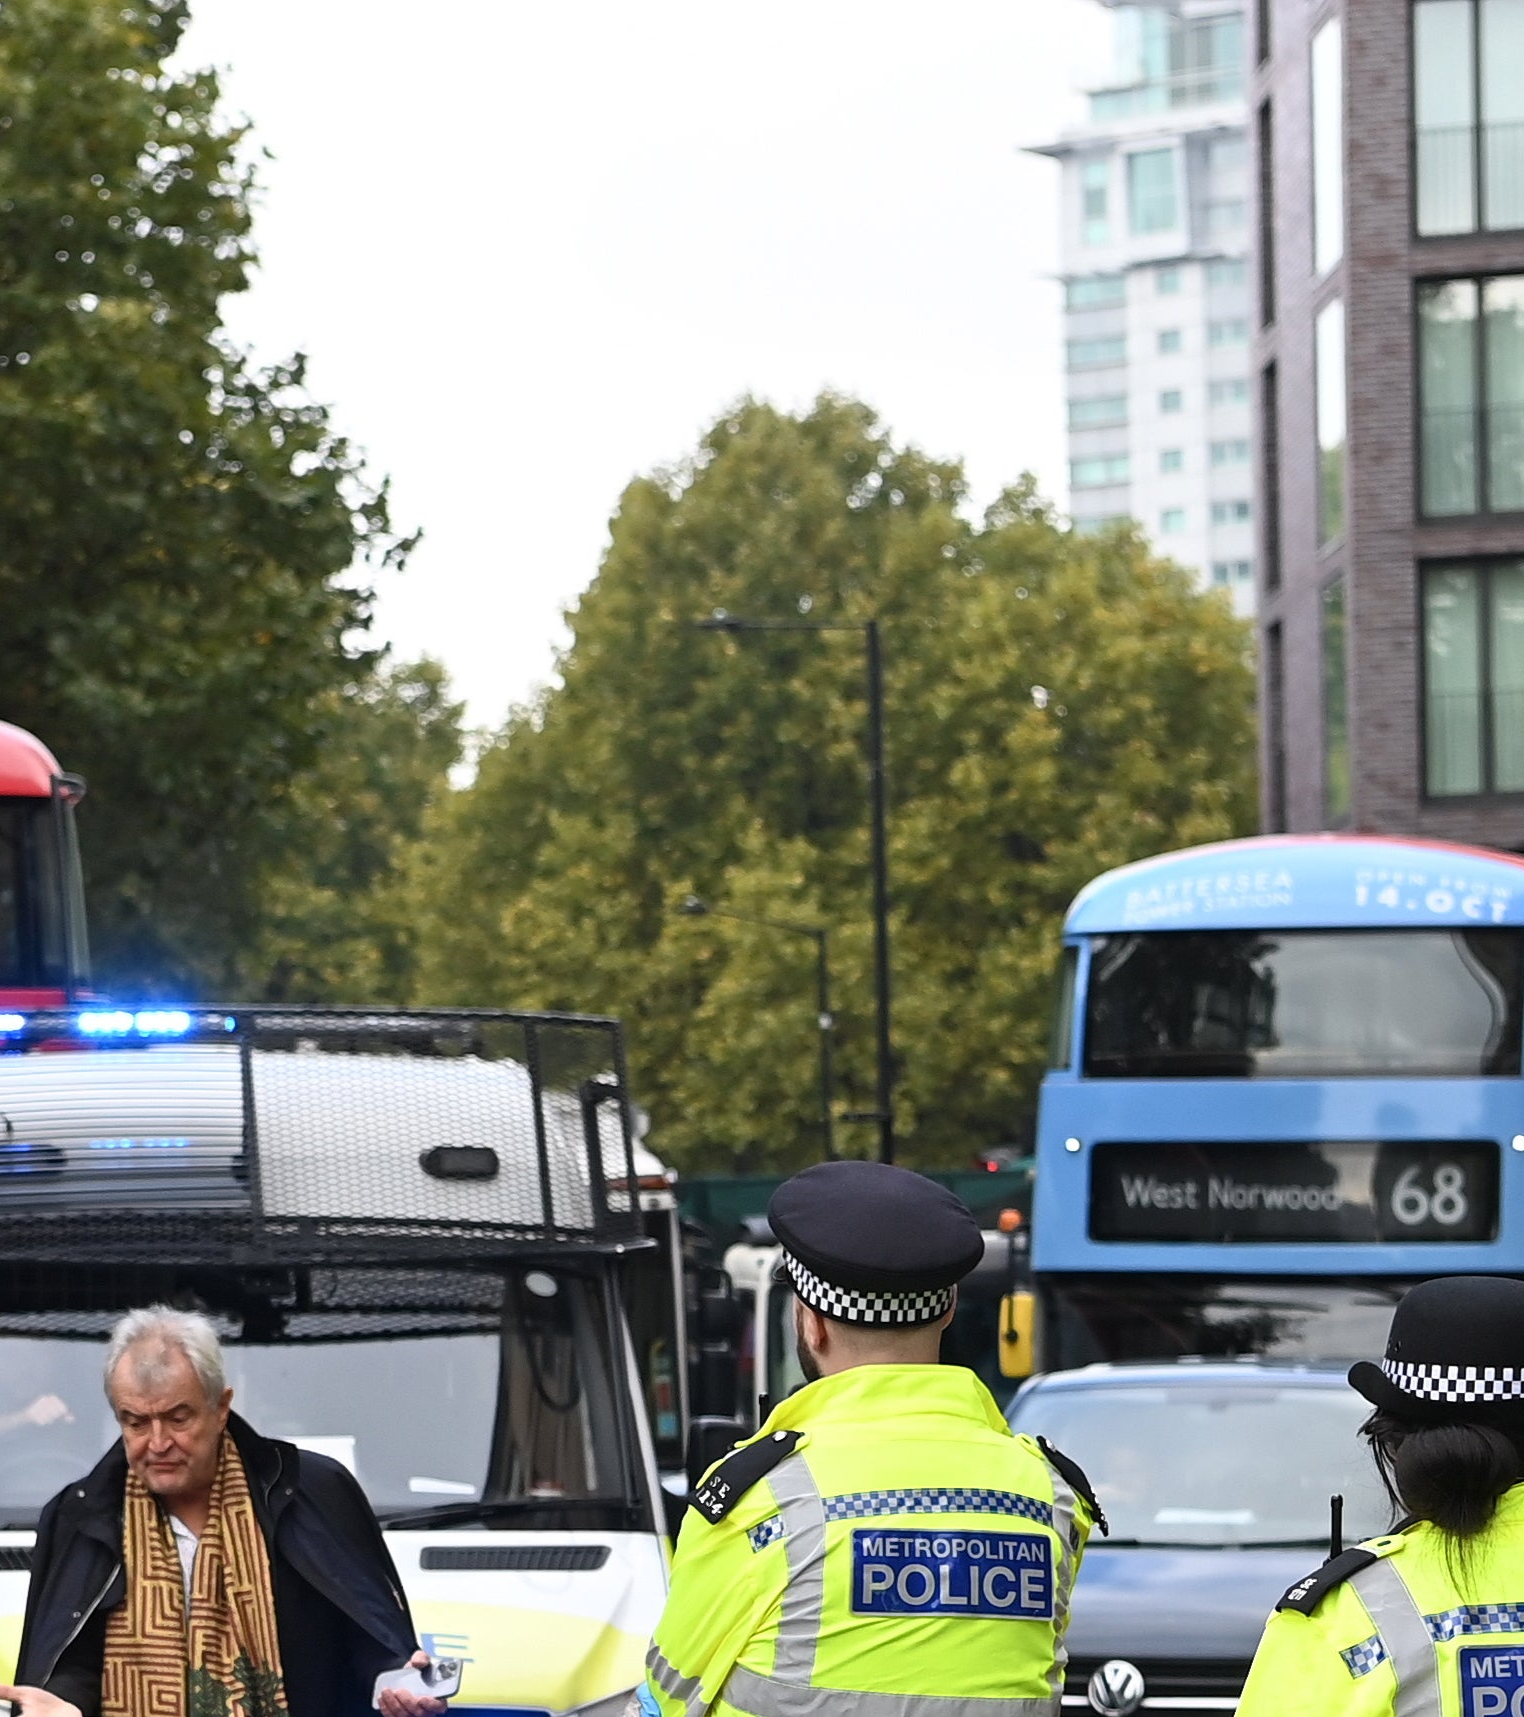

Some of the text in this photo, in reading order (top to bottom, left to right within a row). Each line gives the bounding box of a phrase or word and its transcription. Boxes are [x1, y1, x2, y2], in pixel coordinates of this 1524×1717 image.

[1121, 1174, 1343, 1211] West Norwood
[1390, 1163, 1468, 1225] 68
[862, 1537, 1044, 1563] METROPOLITAN
[862, 1563, 1045, 1610] POLICE
